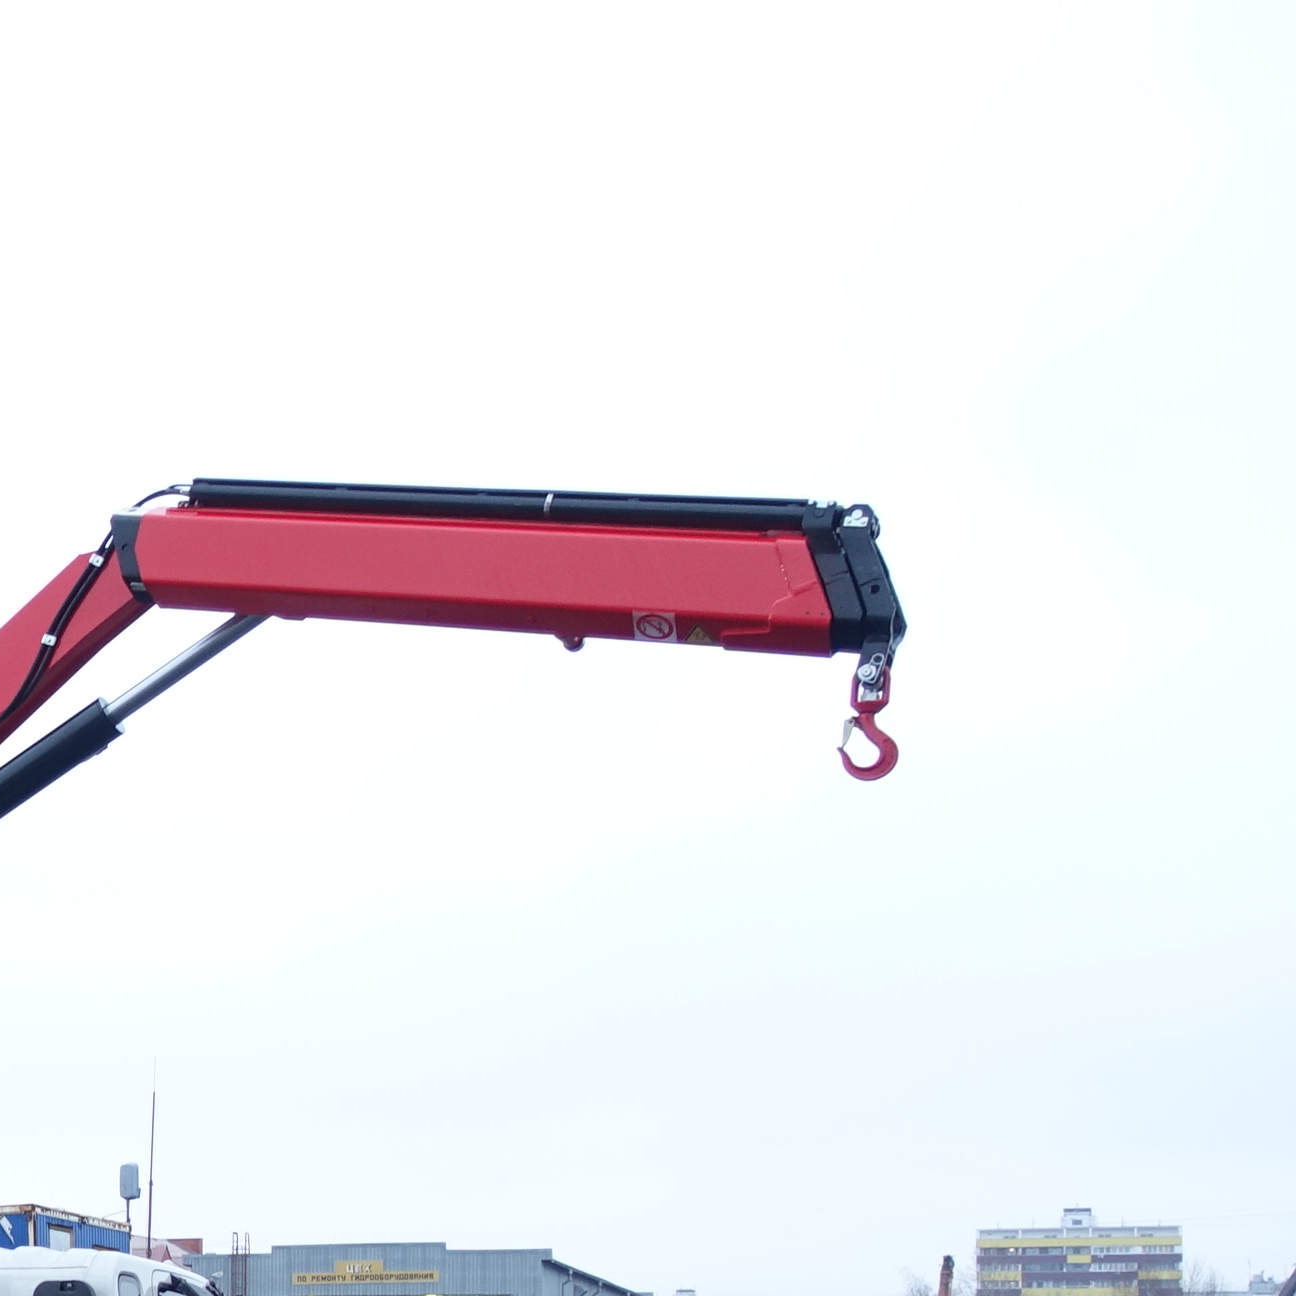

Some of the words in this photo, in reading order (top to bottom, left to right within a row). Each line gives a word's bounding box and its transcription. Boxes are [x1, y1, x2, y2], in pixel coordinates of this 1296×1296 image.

[296, 1275, 307, 1283] ПО
[311, 1274, 346, 1282] РЕМОНТУ
[350, 1272, 434, 1281] ГИДРООБОРУДОВАНИЯ
